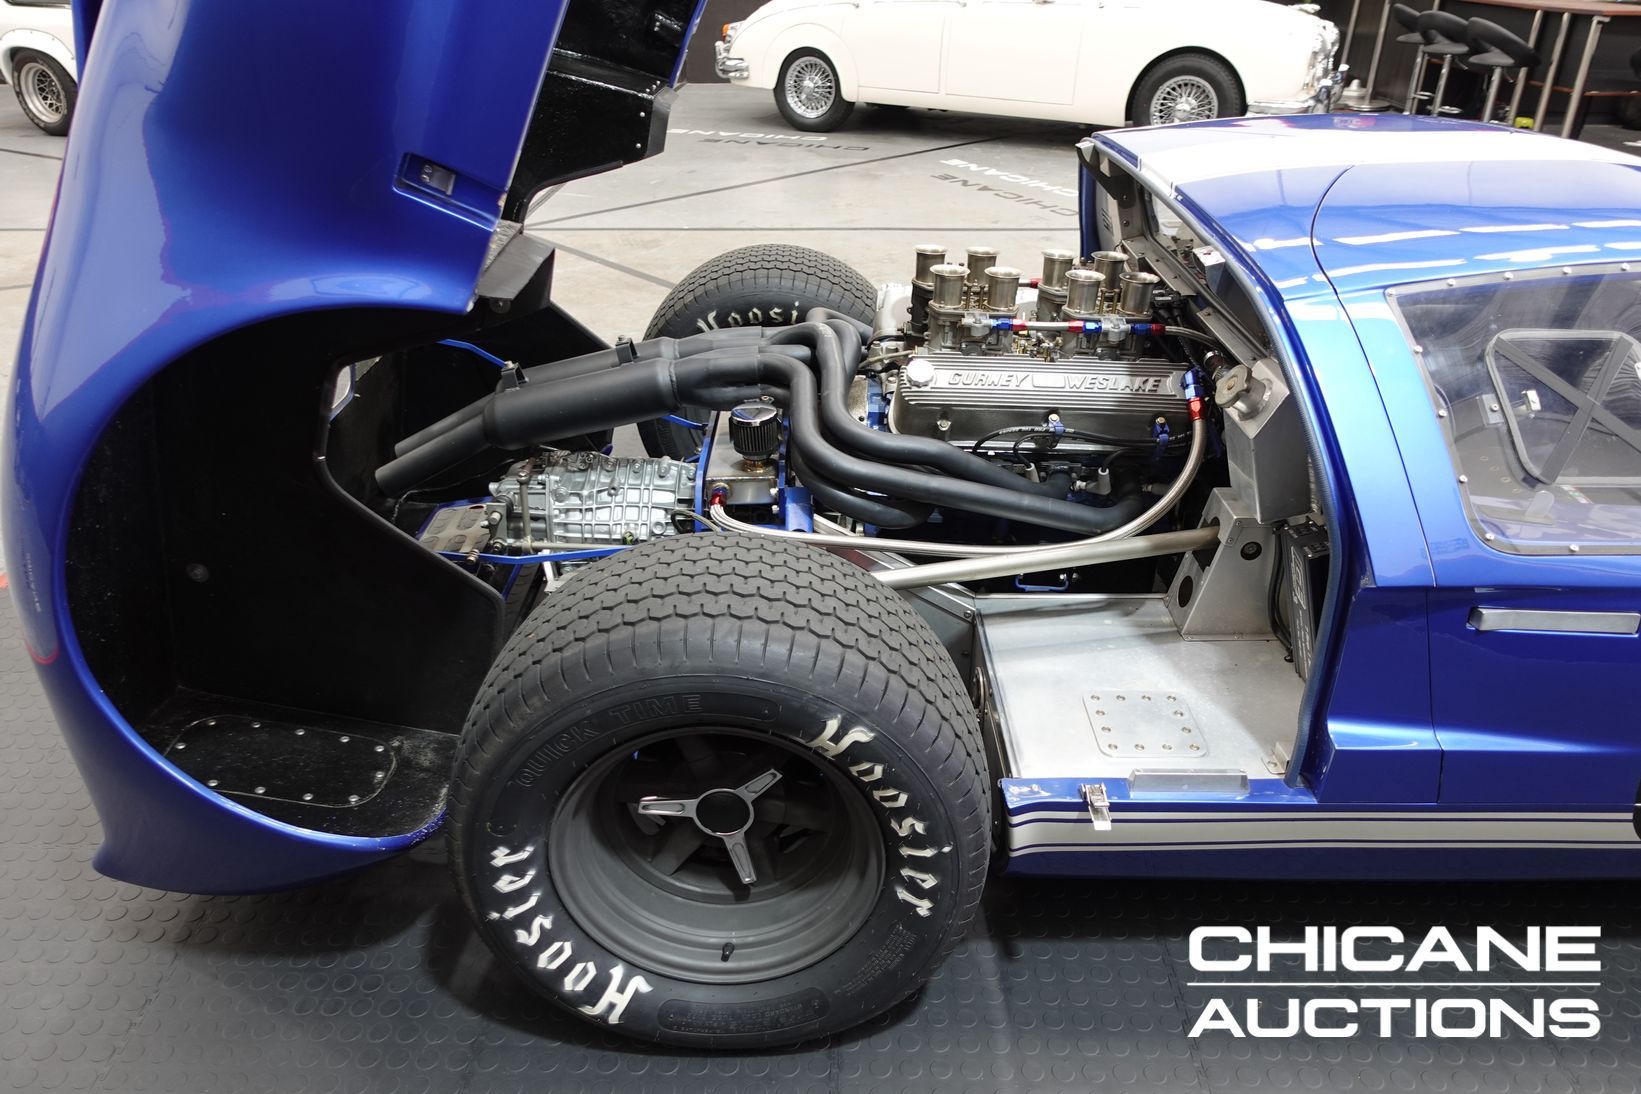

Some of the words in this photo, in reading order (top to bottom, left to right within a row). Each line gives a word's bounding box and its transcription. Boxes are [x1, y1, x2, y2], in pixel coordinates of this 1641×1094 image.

[930, 173, 1080, 217] CHICANE
[948, 372, 1030, 388] GURNEY
[1067, 375, 1163, 392] WESLAKE
[517, 721, 602, 788] QUICK
[609, 694, 704, 724] TIME
[805, 714, 954, 918] Hoosier
[484, 846, 654, 1025] Hoosier
